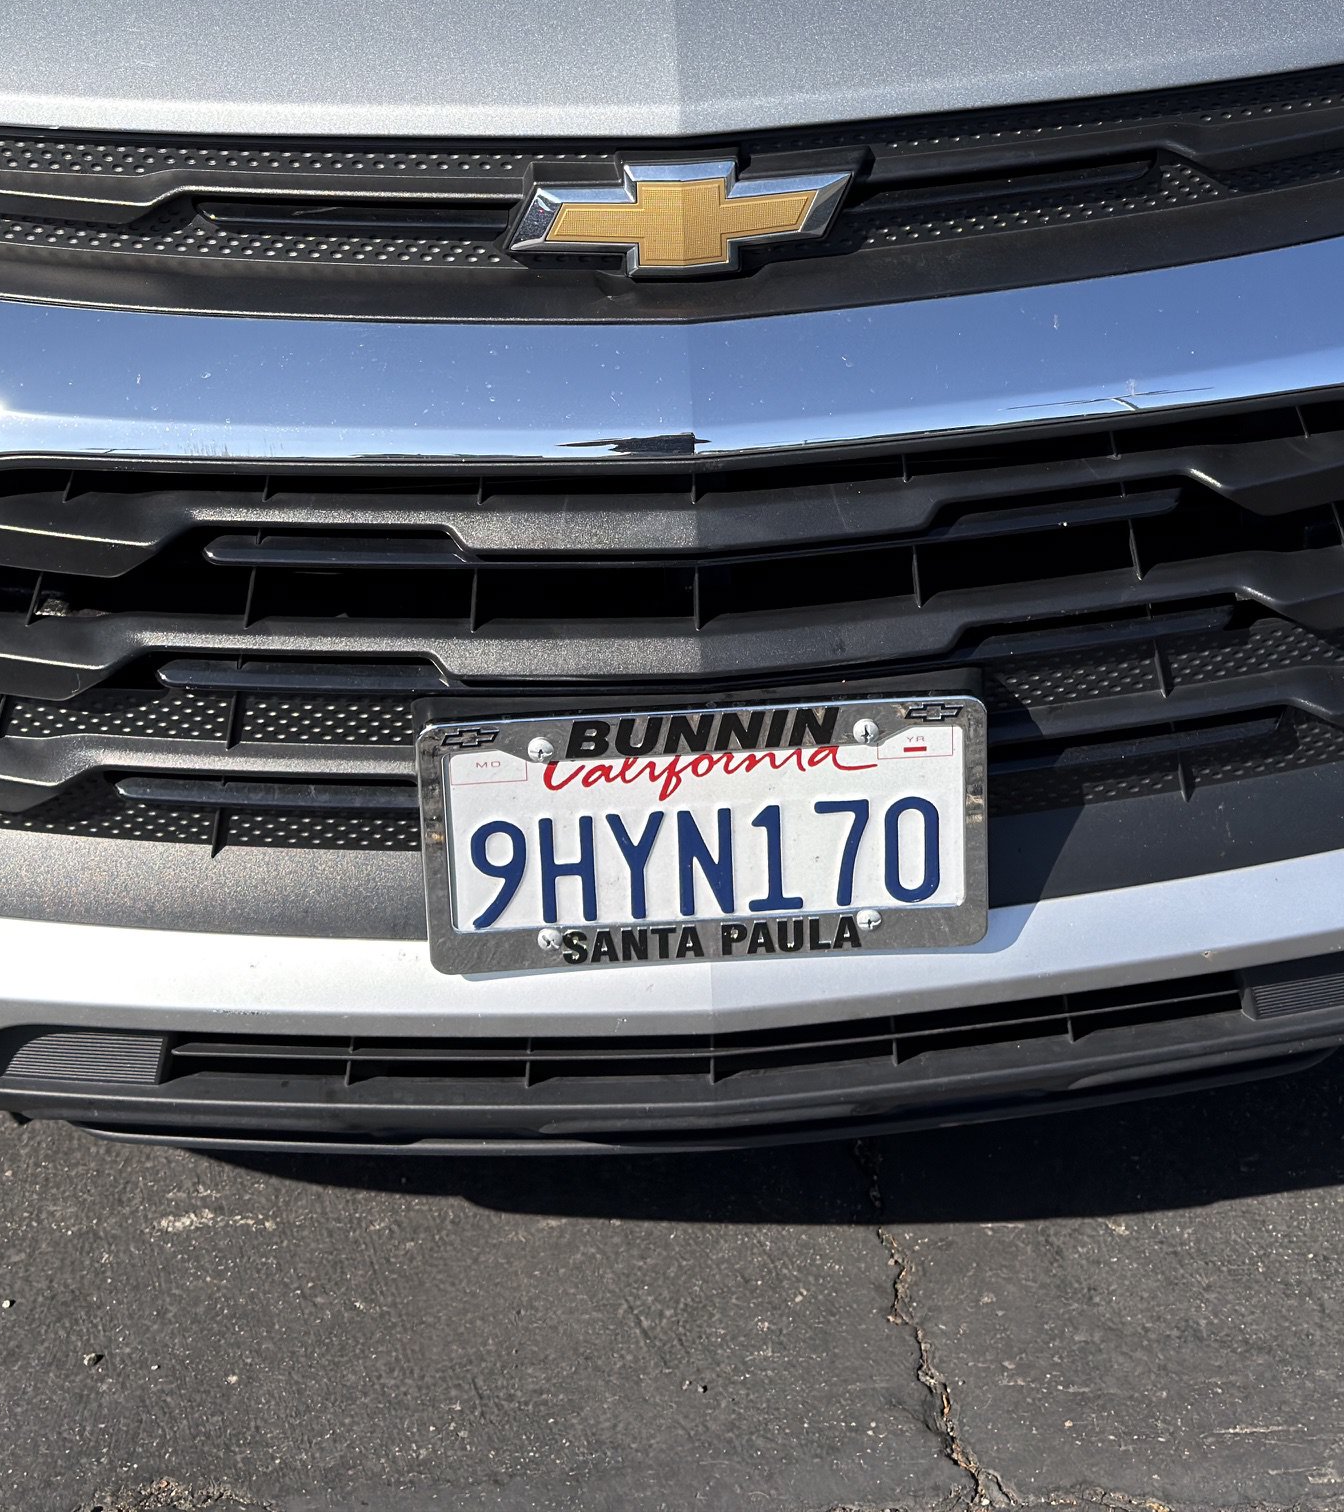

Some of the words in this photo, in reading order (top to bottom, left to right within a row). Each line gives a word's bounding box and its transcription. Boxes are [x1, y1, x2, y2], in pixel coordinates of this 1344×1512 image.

[565, 706, 840, 759] BUNNIN
[906, 735, 926, 743] YR
[475, 759, 501, 768] MO
[542, 745, 879, 801] California
[469, 796, 941, 929] 9HYN170
[561, 924, 713, 965] SANTA
[721, 915, 862, 957] PAULA
